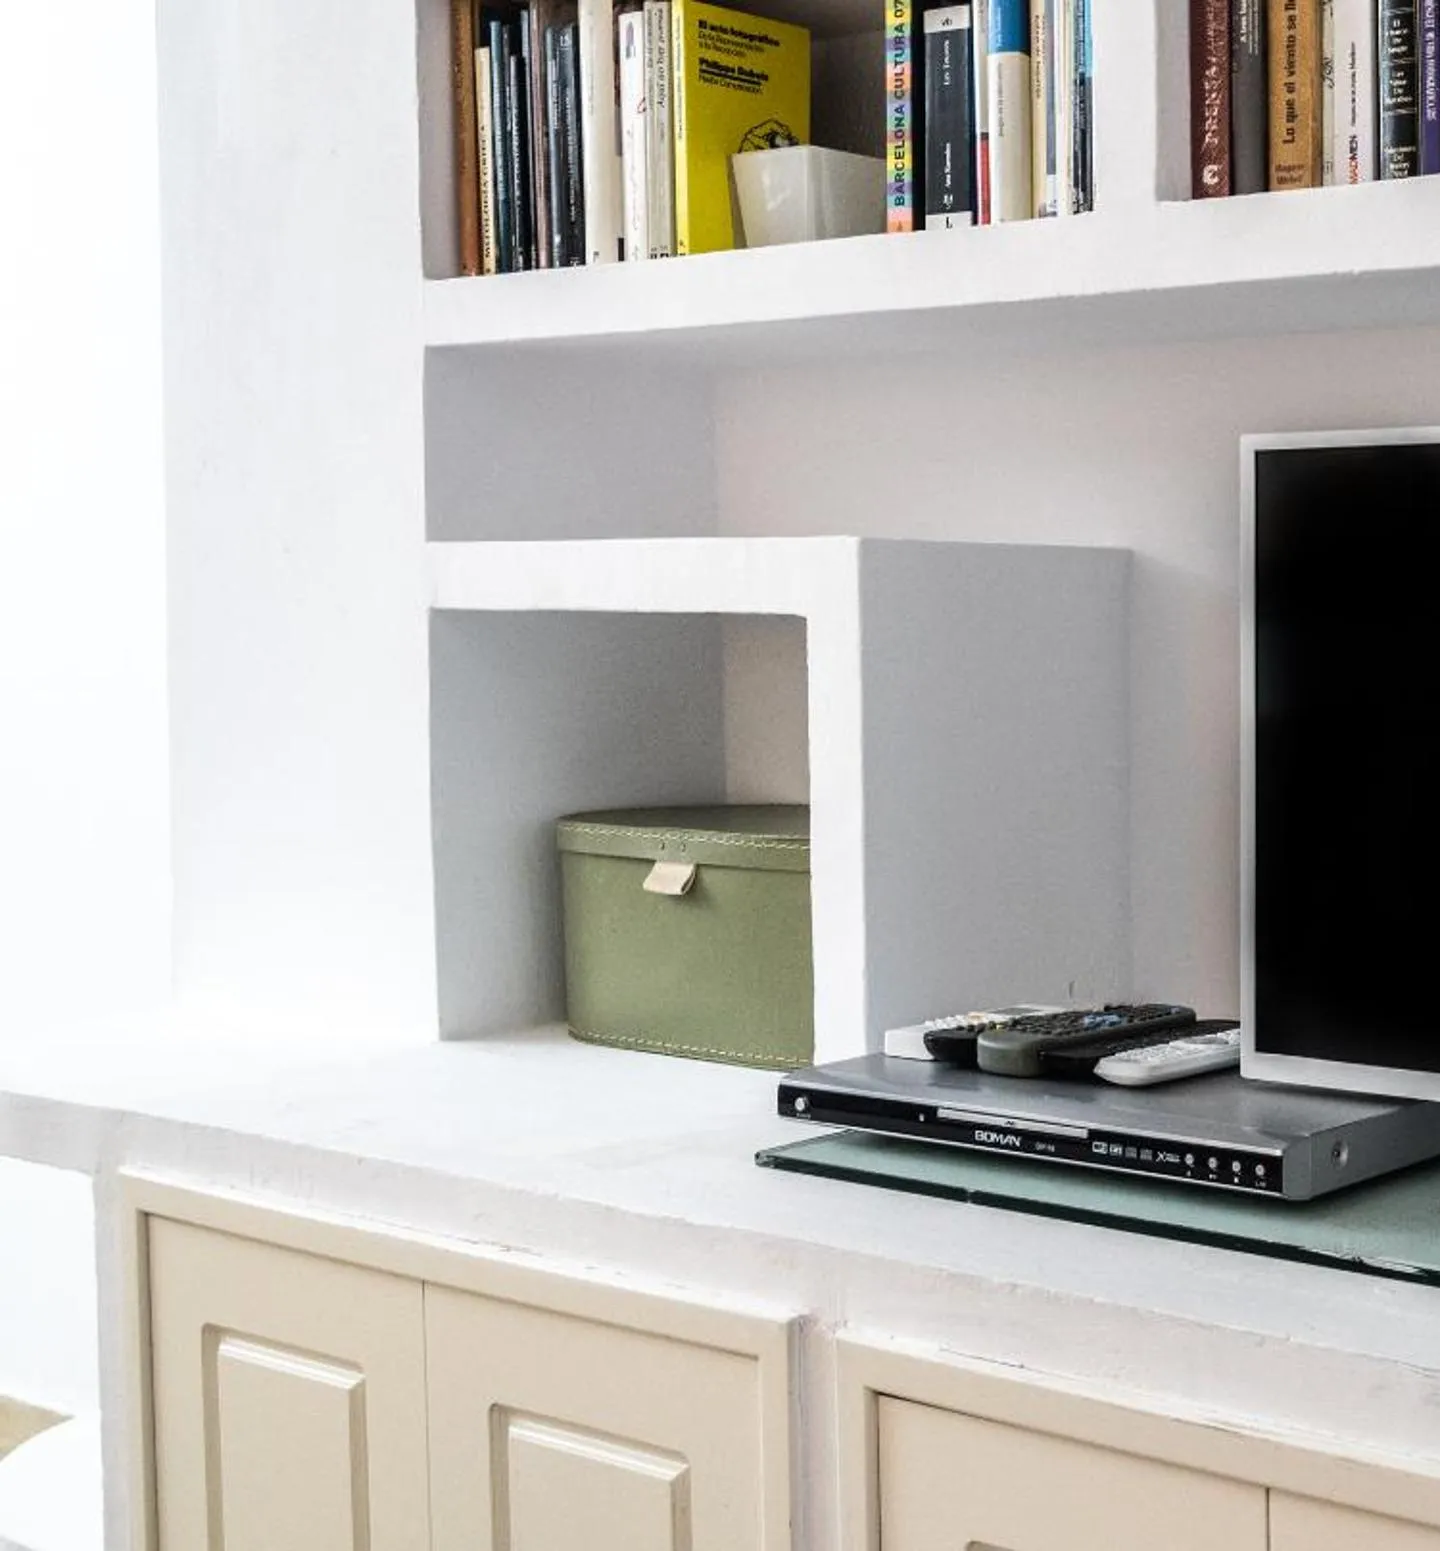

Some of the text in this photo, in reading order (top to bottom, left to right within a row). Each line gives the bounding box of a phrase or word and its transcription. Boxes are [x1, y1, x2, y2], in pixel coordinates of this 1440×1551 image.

[1286, 14, 1296, 31] se
[893, 22, 905, 101] CULTURA
[1283, 34, 1296, 77] viento
[1283, 82, 1295, 93] el
[1203, 65, 1219, 145] PRENSA
[1283, 99, 1298, 123] que
[1282, 128, 1295, 144] Lo
[893, 104, 905, 208] BARCELONA
[974, 1129, 1022, 1148] BOMAN
